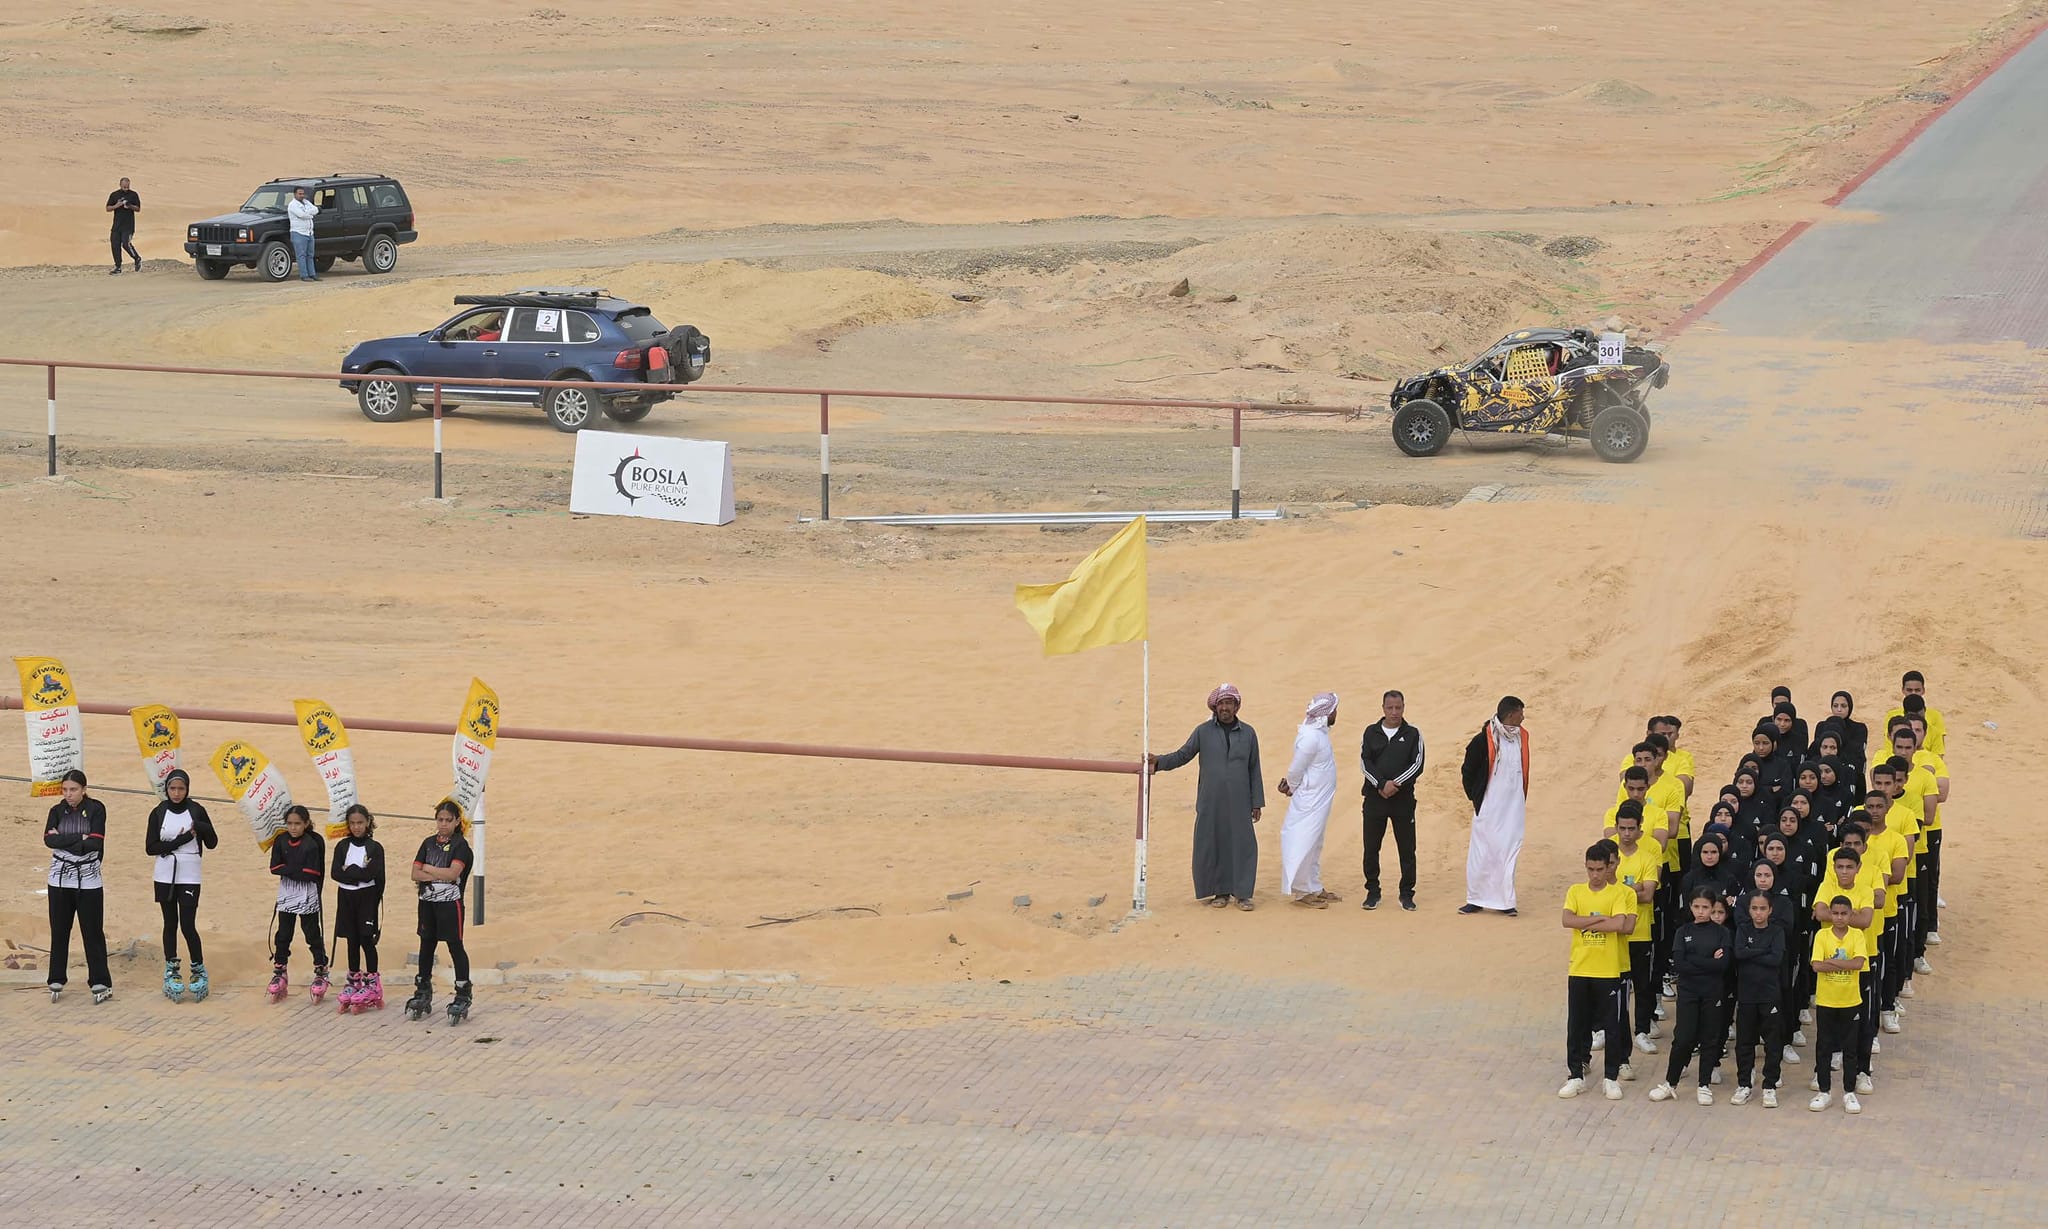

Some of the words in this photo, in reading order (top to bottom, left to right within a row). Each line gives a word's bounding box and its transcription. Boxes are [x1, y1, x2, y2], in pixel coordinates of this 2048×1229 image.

[543, 315, 551, 325] 2
[1600, 346, 1620, 357] 301
[632, 466, 688, 486] BOSLA
[631, 483, 653, 492] PURE
[654, 485, 688, 495] RACING
[32, 666, 64, 679] Elwadi
[32, 689, 69, 704] Skate
[40, 708, 69, 721] اسكيت
[306, 710, 333, 725] Elwadi
[42, 723, 69, 738] الوادي
[308, 732, 337, 750] Skate
[223, 743, 241, 769] Elwadi
[235, 757, 256, 786] Skate
[247, 772, 269, 799] اسكيت
